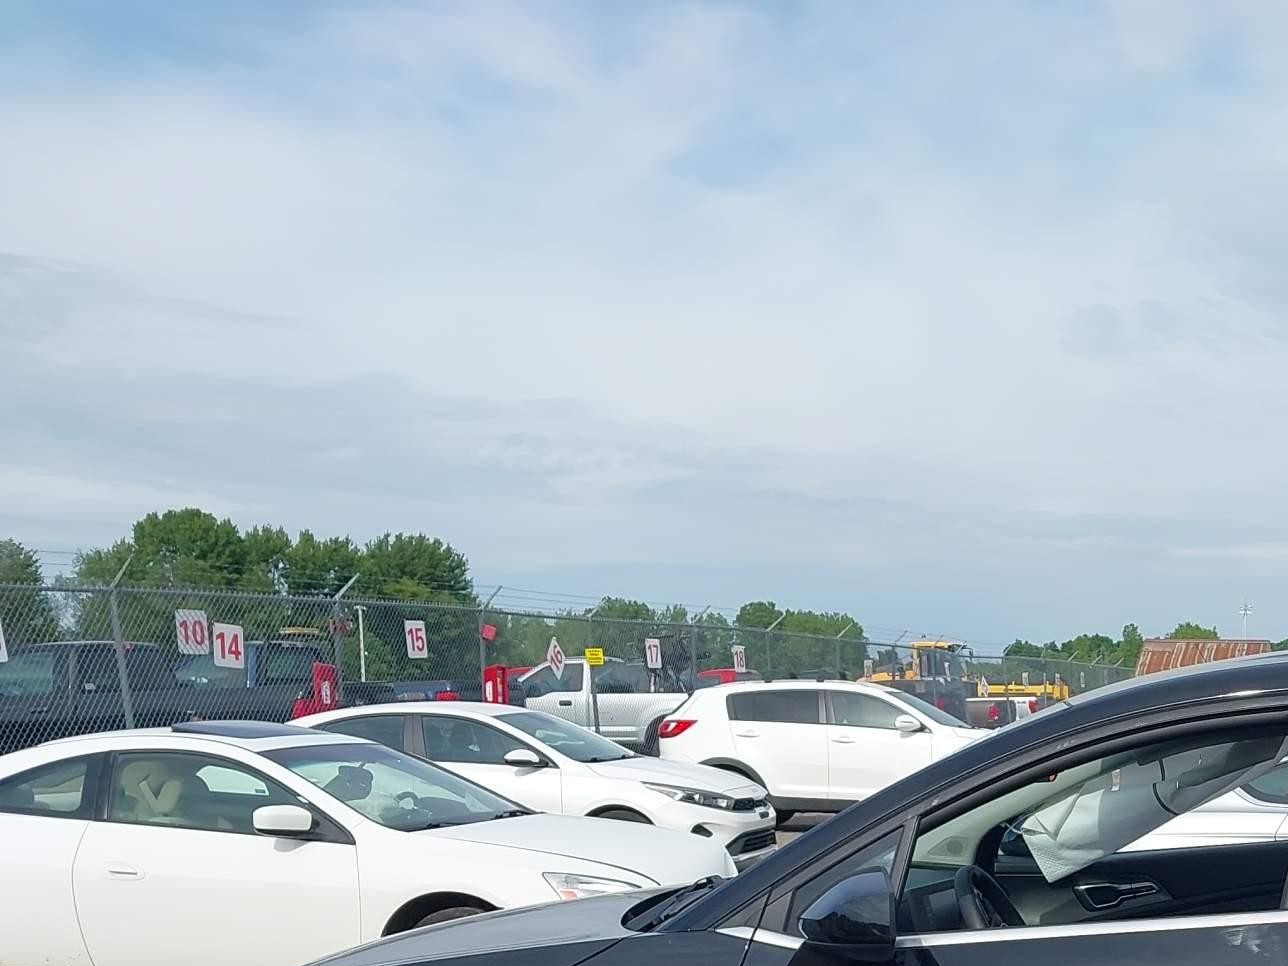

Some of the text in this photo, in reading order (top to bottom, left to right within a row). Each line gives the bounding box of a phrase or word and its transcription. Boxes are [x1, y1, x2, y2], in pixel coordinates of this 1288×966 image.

[180, 620, 205, 646] 10
[407, 627, 425, 652] 15
[215, 632, 242, 661] 14
[550, 644, 563, 671] 16
[647, 644, 659, 664] 17
[734, 650, 745, 669] 18
